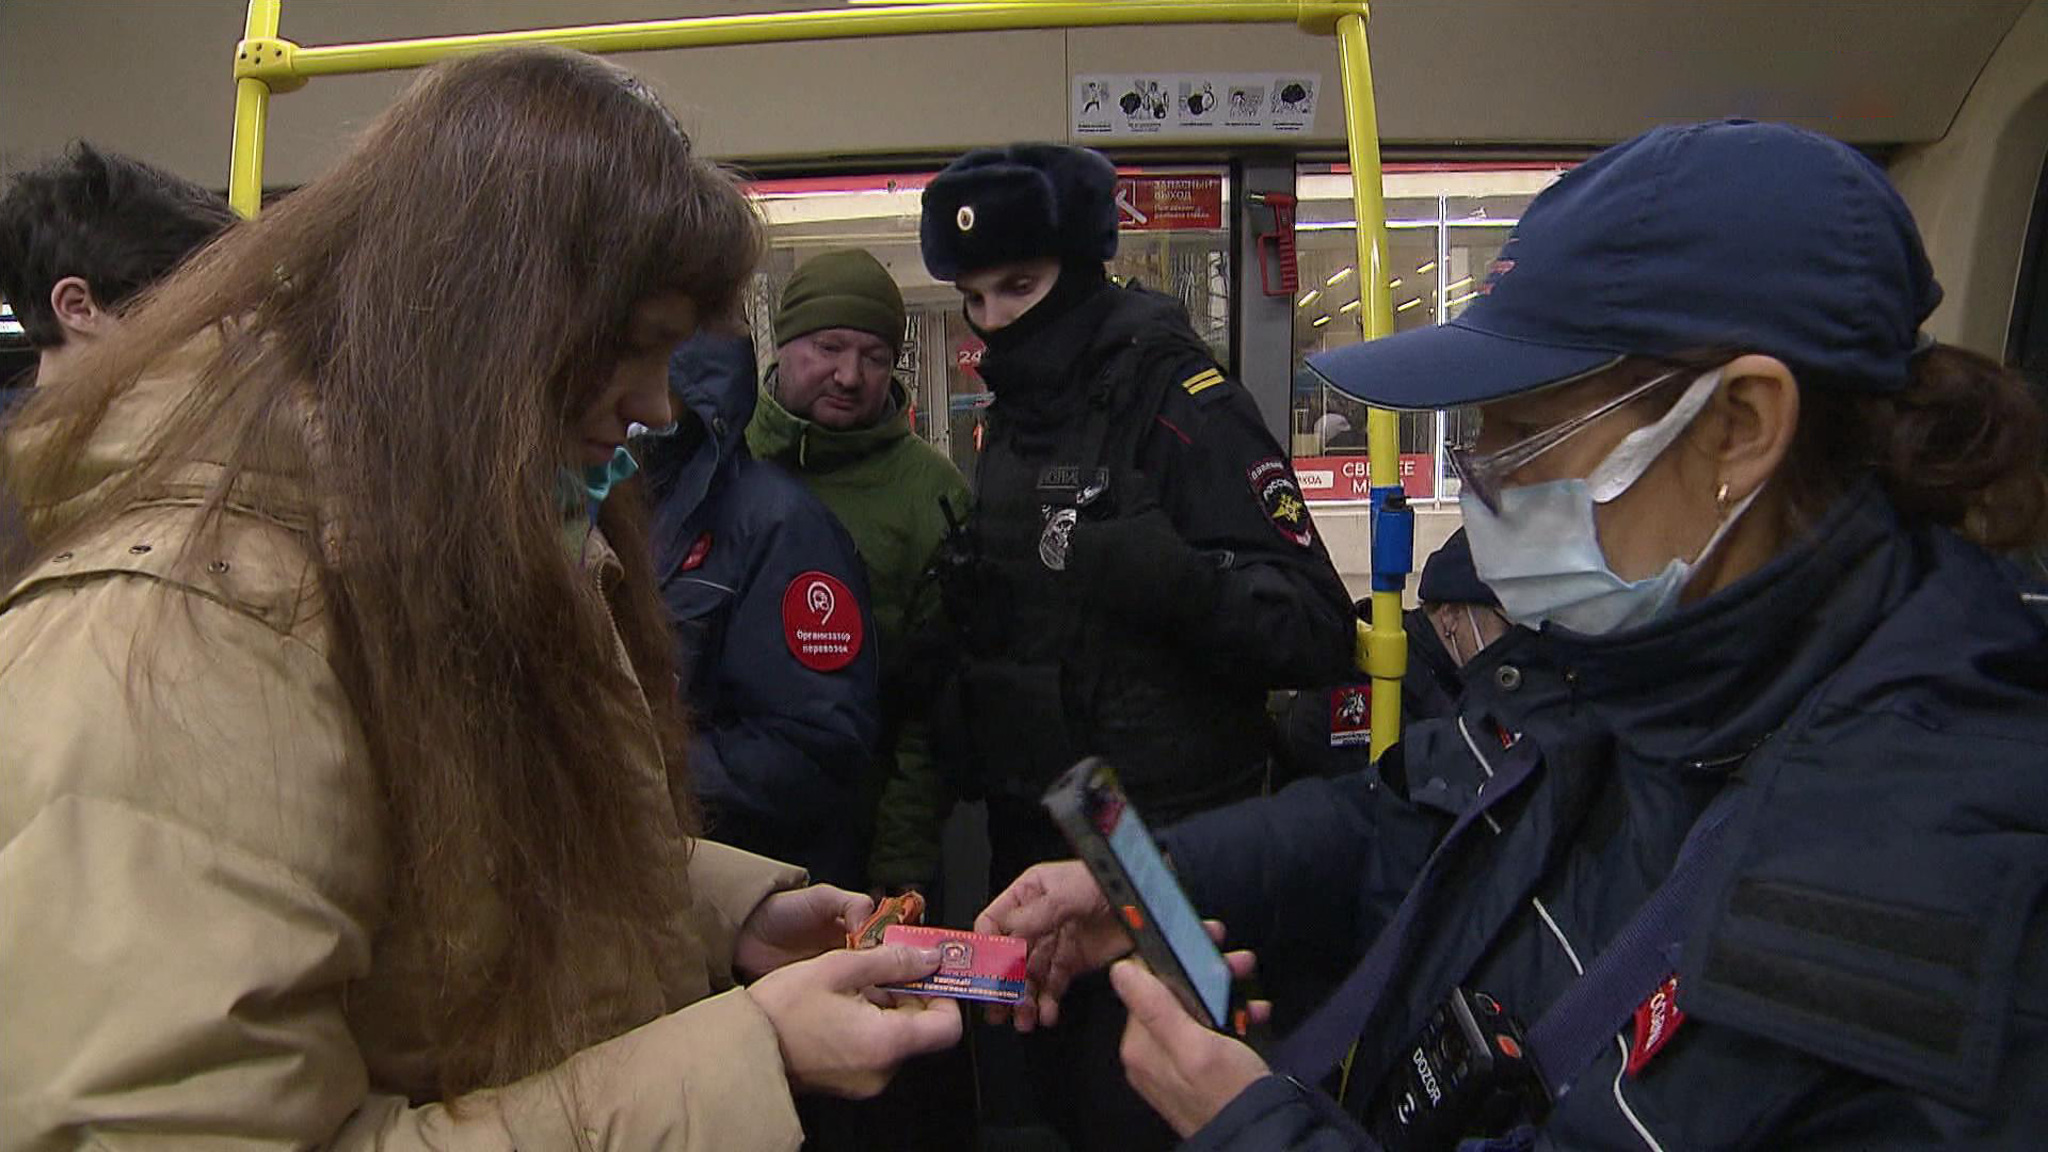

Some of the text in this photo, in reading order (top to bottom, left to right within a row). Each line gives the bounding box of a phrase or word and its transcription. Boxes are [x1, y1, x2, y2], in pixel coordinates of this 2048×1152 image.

[1154, 179, 1213, 190] ЗАПАСНЫЙ
[1154, 189, 1192, 200] ВЫХОД
[796, 629, 851, 642] Организатор
[802, 645, 848, 655] перевозок
[1412, 1047, 1442, 1109] DOZOR
